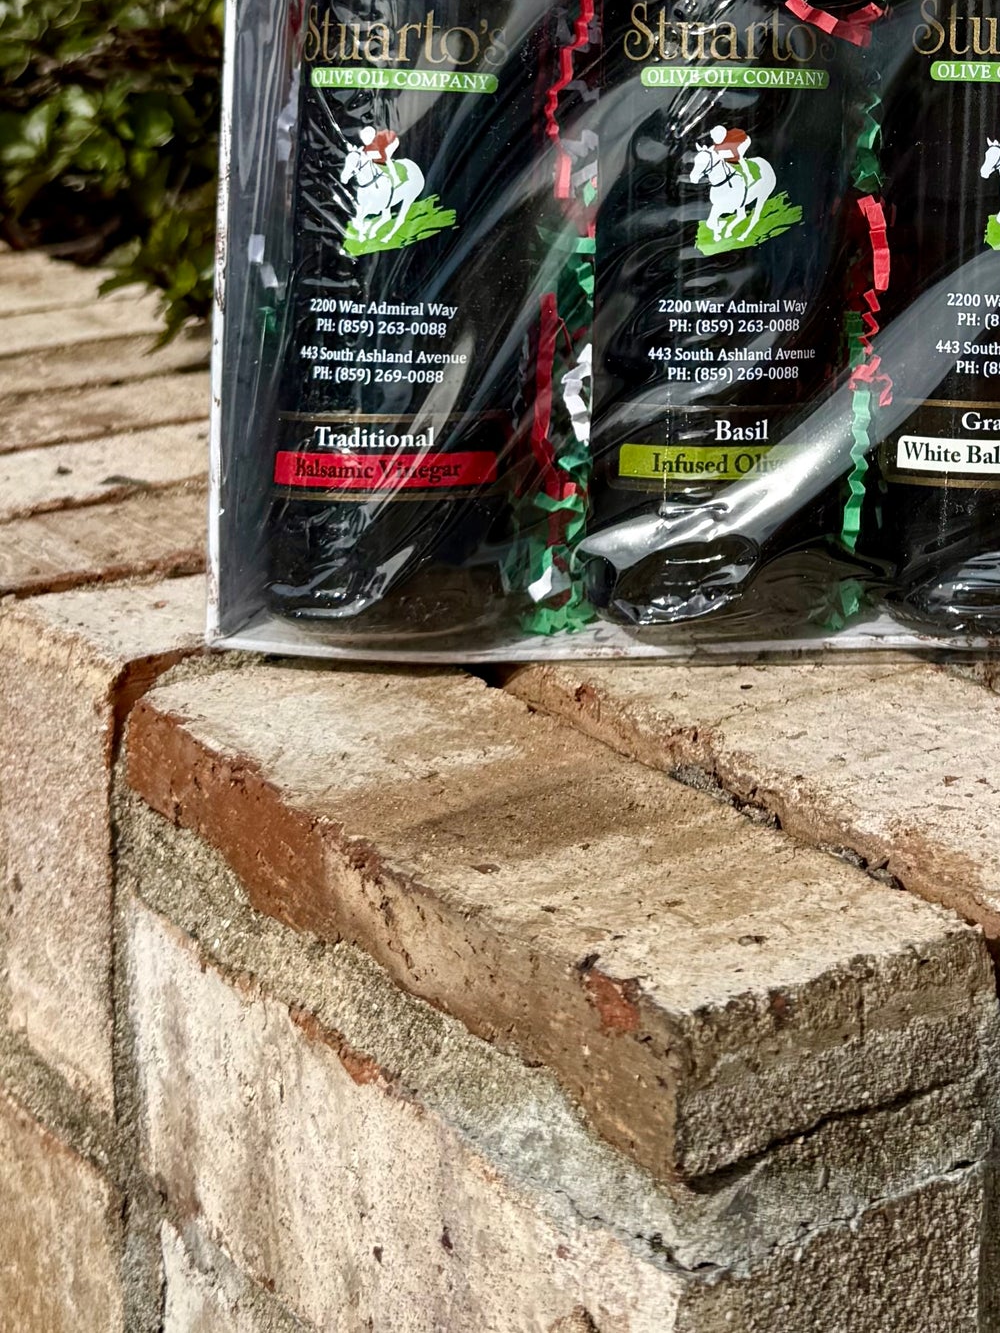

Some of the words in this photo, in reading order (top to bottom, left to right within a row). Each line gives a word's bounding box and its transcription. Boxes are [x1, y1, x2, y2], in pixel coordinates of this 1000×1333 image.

[303, 3, 508, 66] Stuarto's
[314, 69, 353, 86] OLIVE
[358, 70, 389, 87] OIL
[394, 71, 491, 90] COMPANY
[647, 69, 701, 85] OLIVE
[704, 69, 738, 84] OIL
[743, 70, 825, 86] COMPANY
[937, 64, 991, 79] OLIVE
[310, 298, 337, 313] 2200
[339, 300, 366, 315] War
[367, 301, 424, 316] Admiral
[428, 303, 458, 319] Way
[658, 299, 692, 313] 2200
[695, 301, 724, 314] War
[727, 300, 780, 313] Admiral
[783, 299, 808, 315] Way
[947, 293, 980, 307] 2200
[316, 318, 336, 332] PH:
[338, 319, 374, 337] (859)
[378, 321, 447, 335] 263-0088
[669, 319, 692, 332] PH:
[695, 319, 734, 336] (859)
[738, 319, 800, 332] 263-0088
[957, 312, 980, 326] PH:
[300, 345, 318, 360] 443
[319, 347, 354, 362] South
[356, 349, 413, 364] Ashland
[416, 351, 467, 364] Avenue
[648, 347, 672, 361] 443
[675, 347, 713, 361] South
[717, 348, 772, 361] Ashland
[775, 348, 816, 361] Avenue
[936, 340, 960, 354] 443
[313, 366, 333, 380] PH:
[335, 367, 371, 385] (859)
[374, 369, 444, 383] 269-0088
[667, 367, 691, 380] PH:
[695, 367, 733, 384] (859)
[737, 367, 799, 380] 269-0088
[956, 360, 979, 374] PH:
[314, 426, 435, 448] Traditional
[714, 419, 769, 441] Basil
[904, 441, 961, 463] White
[295, 458, 374, 479] Balsamic
[379, 459, 462, 482] Vinegar
[653, 453, 728, 474] Infused
